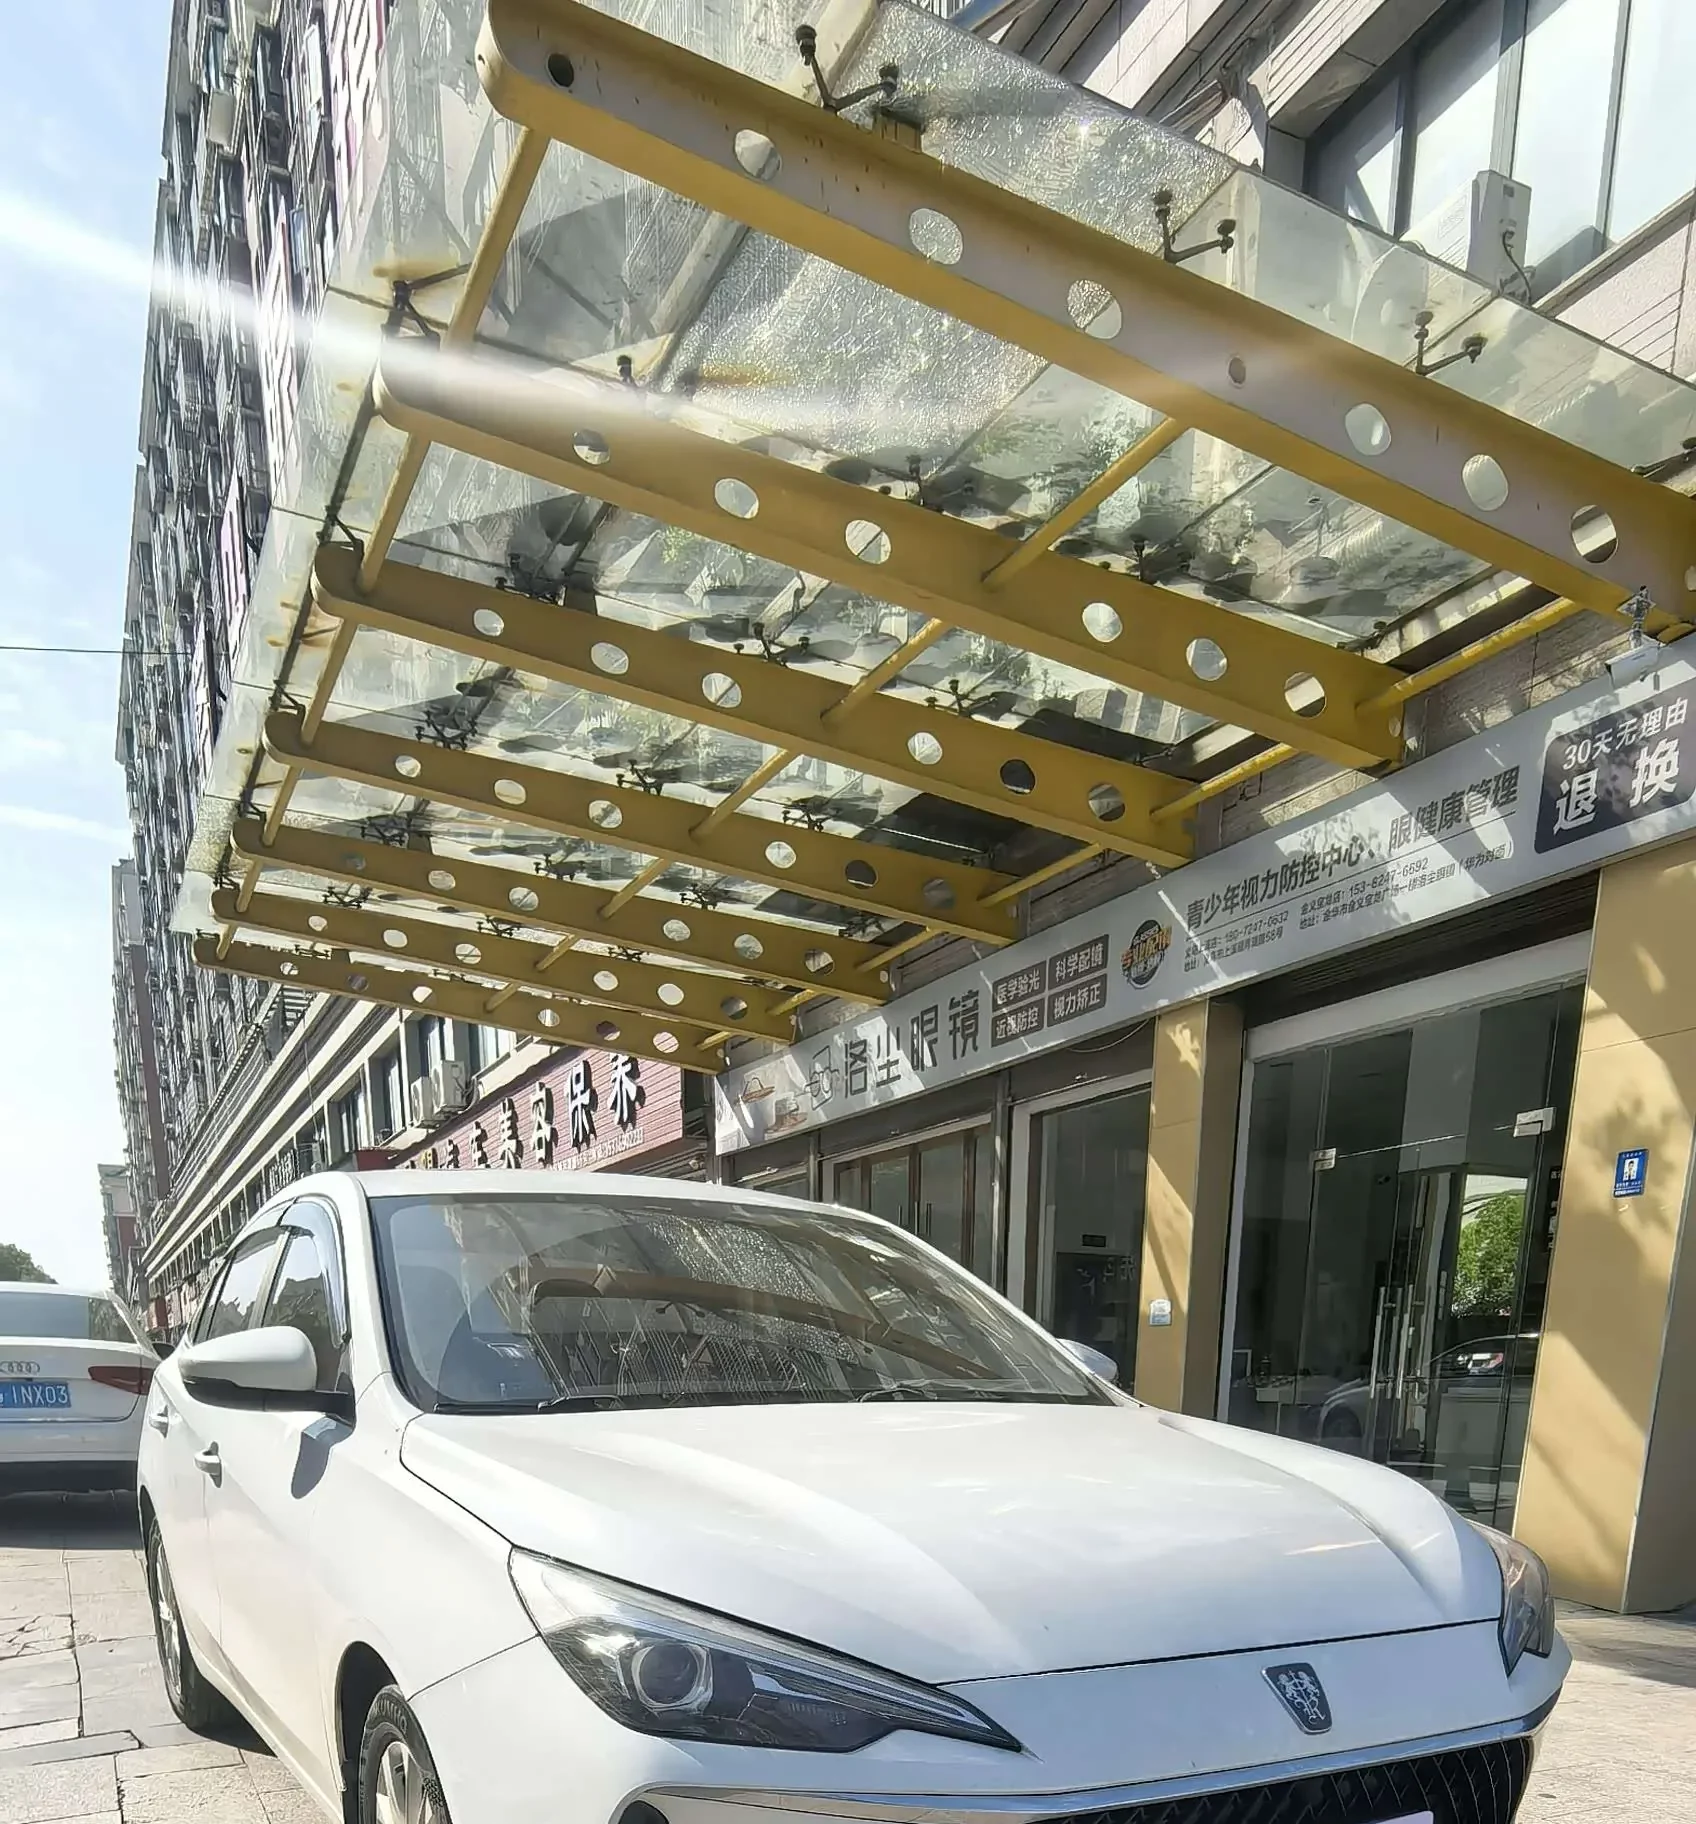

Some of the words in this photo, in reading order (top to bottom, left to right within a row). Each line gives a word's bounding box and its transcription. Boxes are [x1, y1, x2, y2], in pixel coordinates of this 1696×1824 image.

[1563, 697, 1688, 770] 30天无理由
[1187, 764, 1520, 931] 青少年视力防控中心、眼健康管理
[1055, 943, 1104, 983] 科学配镜
[996, 968, 1041, 1005] 医学验光
[1053, 982, 1101, 1020] 视力矫正
[996, 1006, 1039, 1040] 近视防控
[844, 989, 980, 1099] 洛尘眼镜
[0, 1384, 68, 1405] 1NX03
